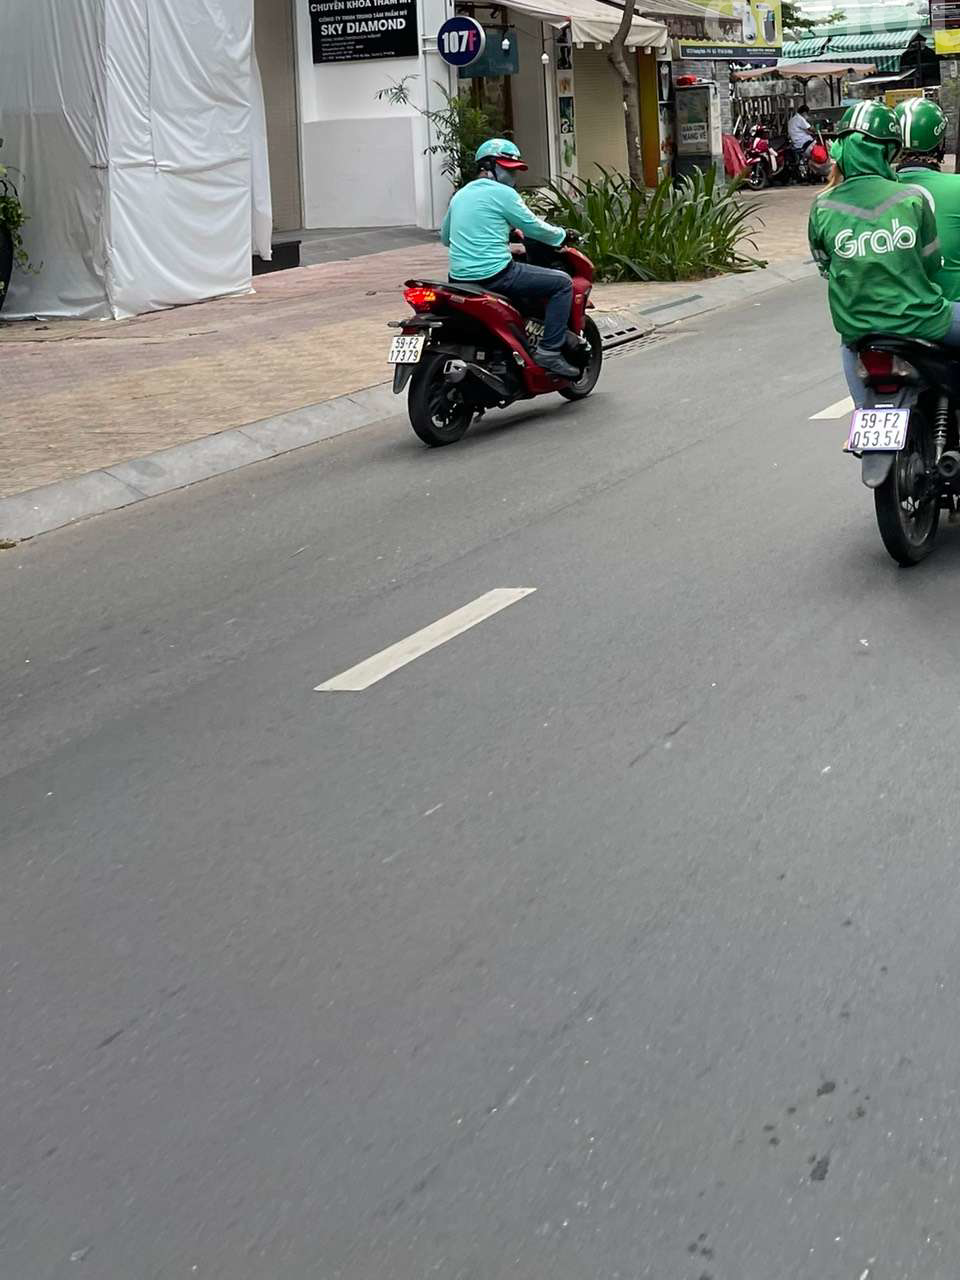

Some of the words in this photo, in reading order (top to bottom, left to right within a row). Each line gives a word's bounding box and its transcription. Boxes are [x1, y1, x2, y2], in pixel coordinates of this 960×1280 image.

[310, 0, 344, 12] CHUYÊN
[347, 0, 371, 9] KHOA
[321, 23, 343, 36] SKY
[346, 18, 406, 34] DIAMOND
[441, 28, 477, 54] 107F
[834, 218, 916, 259] Grab
[395, 337, 419, 349] 59-F2
[861, 412, 900, 429] 59-F2
